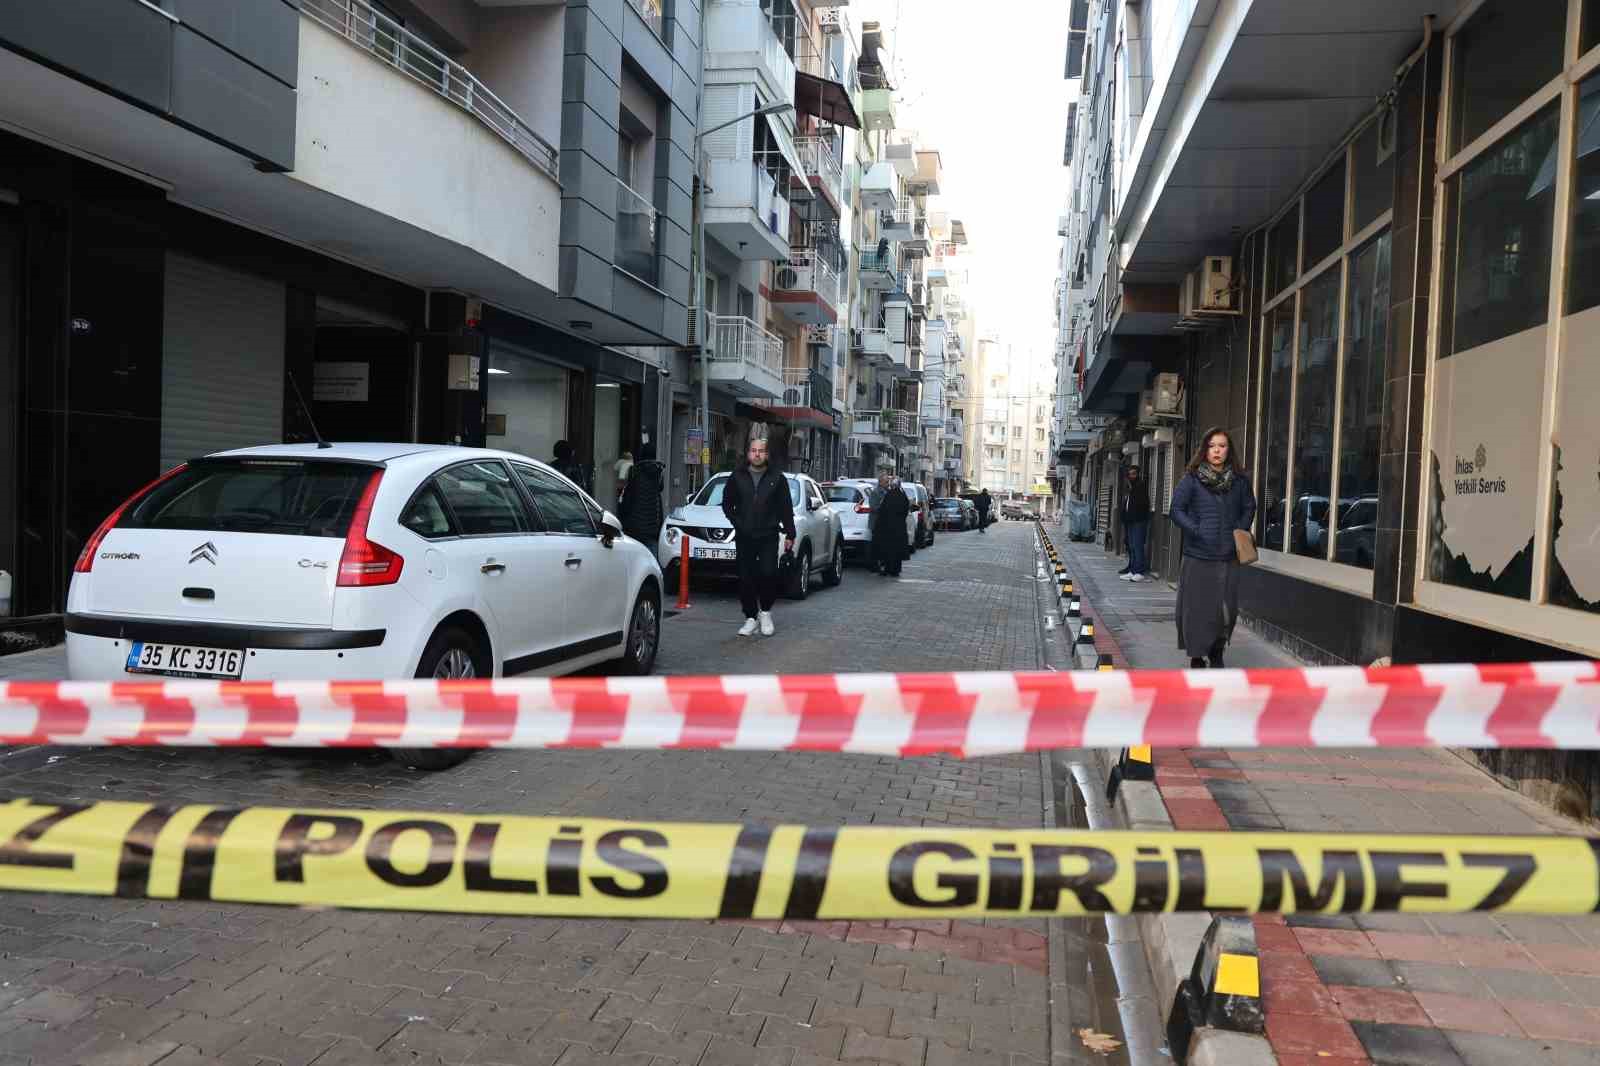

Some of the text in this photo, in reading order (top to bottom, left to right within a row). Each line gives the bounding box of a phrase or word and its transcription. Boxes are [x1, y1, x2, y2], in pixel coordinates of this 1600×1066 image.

[1455, 456, 1474, 474] İhlas
[1454, 476, 1506, 495] Yetkili Servis
[297, 558, 329, 569] C4
[141, 645, 238, 672] 35 KC 3316
[274, 813, 669, 898] POLİS
